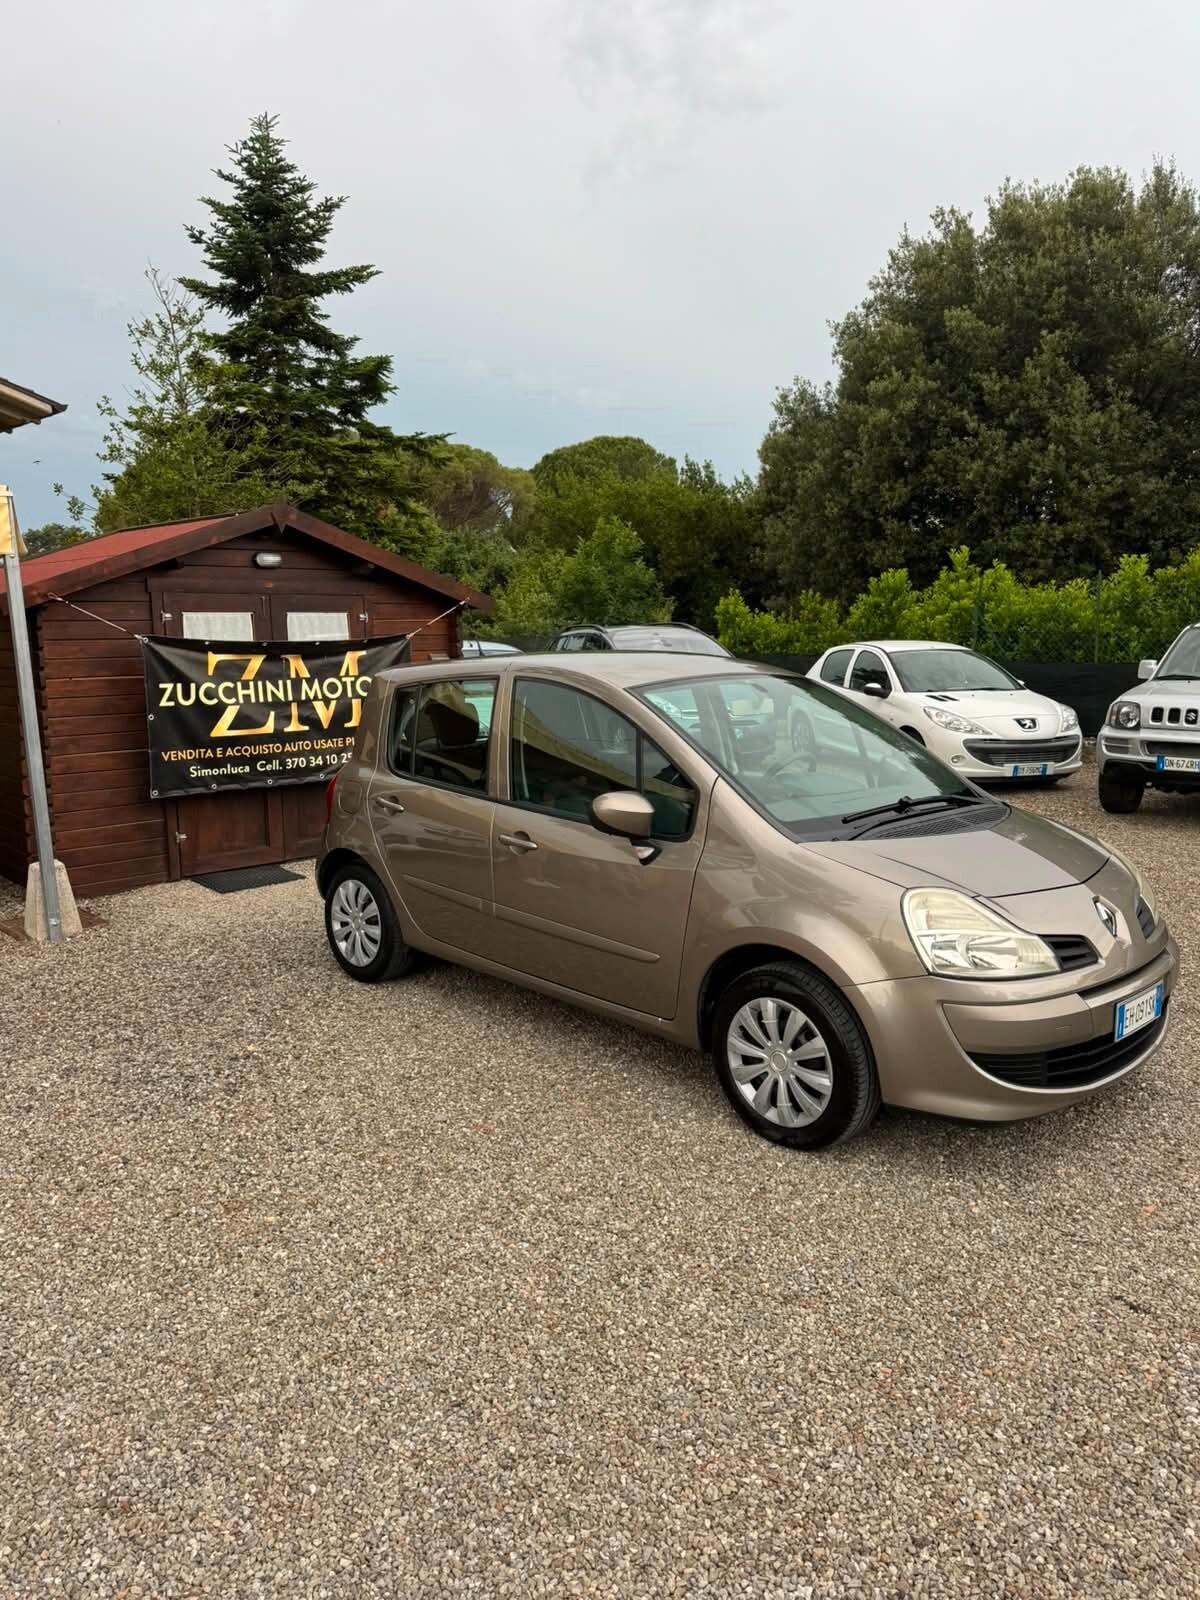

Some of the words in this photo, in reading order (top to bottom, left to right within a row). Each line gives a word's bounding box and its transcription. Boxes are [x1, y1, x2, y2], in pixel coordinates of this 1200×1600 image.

[158, 679, 293, 707] ZUCCHINI
[161, 748, 214, 762] VENDITA
[216, 747, 223, 759] E
[225, 743, 283, 757] ACQUISTO
[284, 741, 312, 753] AUTO
[314, 737, 344, 749] USATE
[189, 764, 250, 778] Simonluca
[256, 758, 283, 772] Cell.
[285, 756, 306, 770] 370
[309, 755, 323, 767] 34
[326, 753, 338, 765] 10
